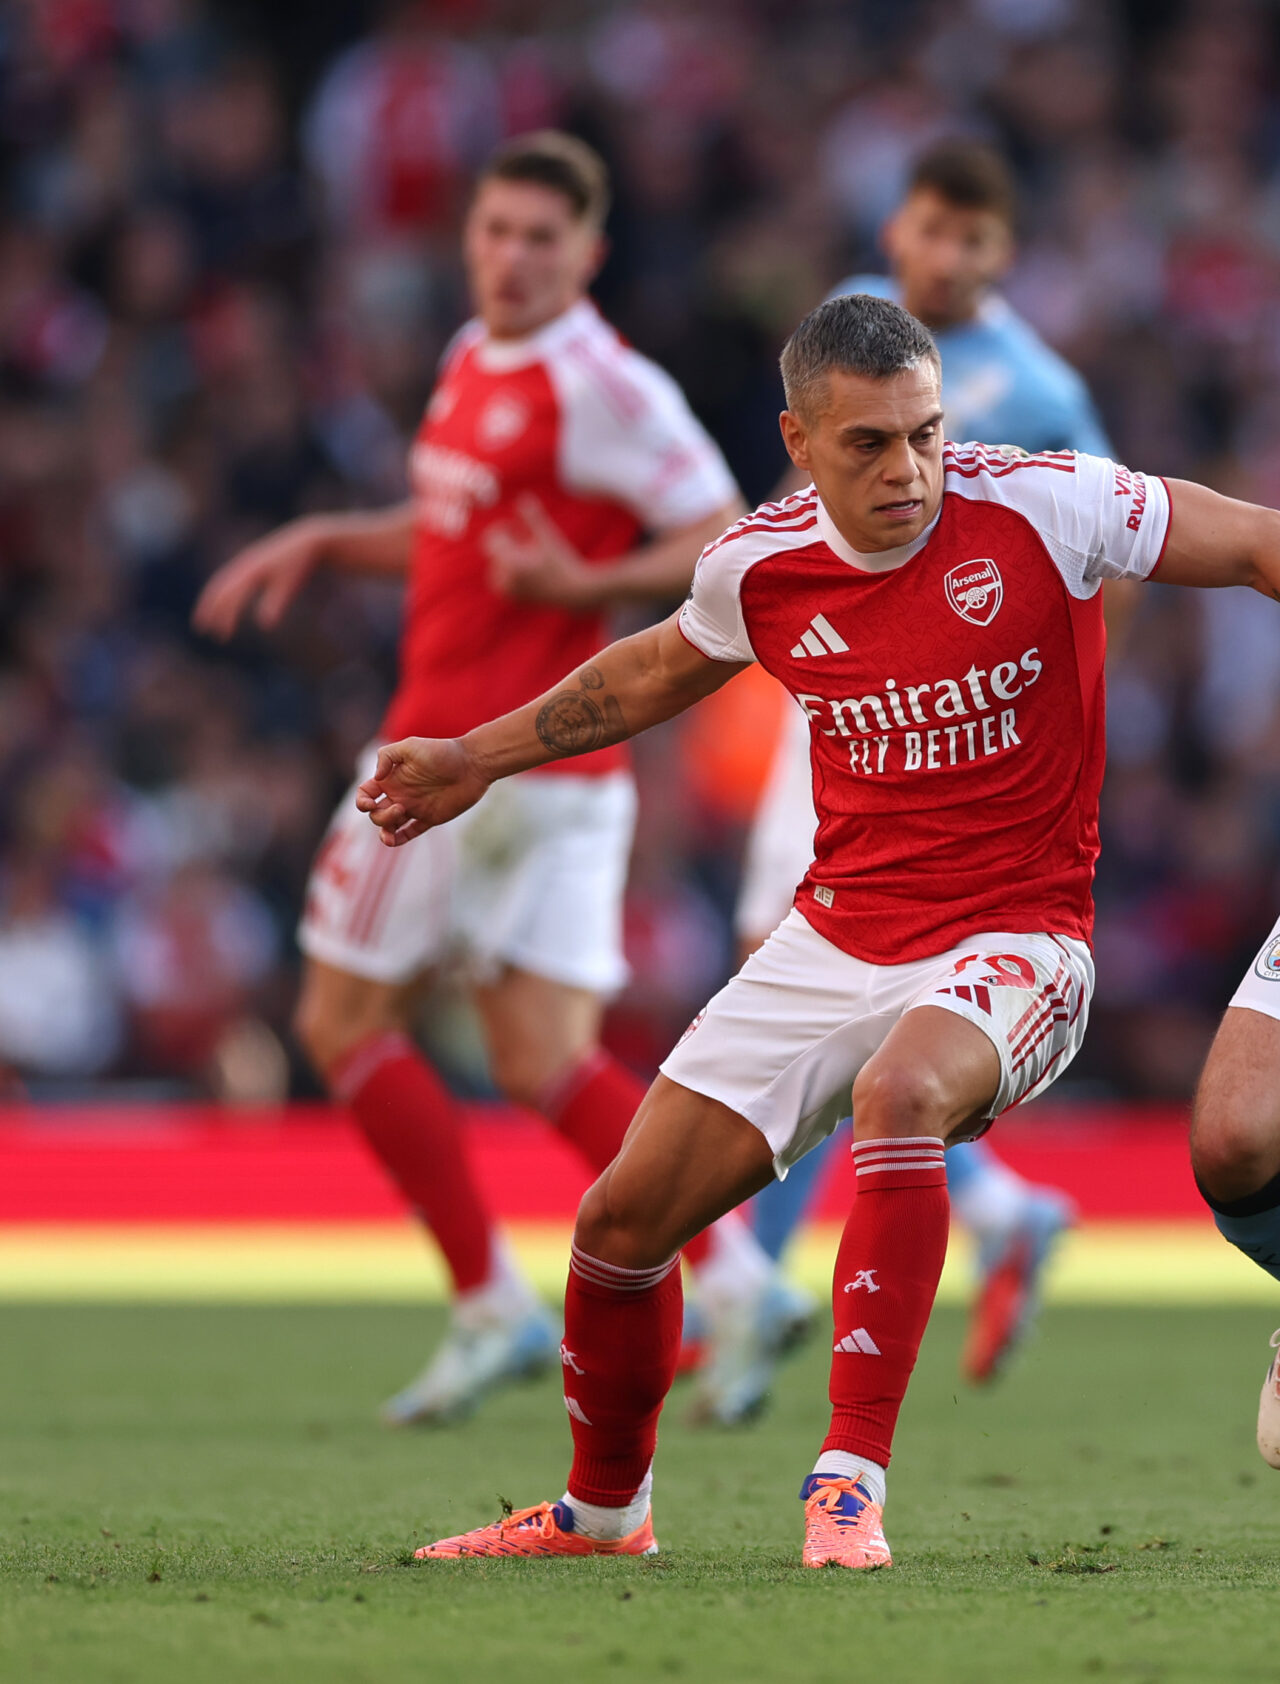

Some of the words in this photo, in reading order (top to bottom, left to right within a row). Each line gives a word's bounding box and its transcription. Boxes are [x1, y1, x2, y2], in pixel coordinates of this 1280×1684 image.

[953, 567, 991, 590] Arsenal
[796, 647, 1043, 737] Emirates
[848, 735, 890, 775] FLY
[904, 708, 1022, 771] BETTER
